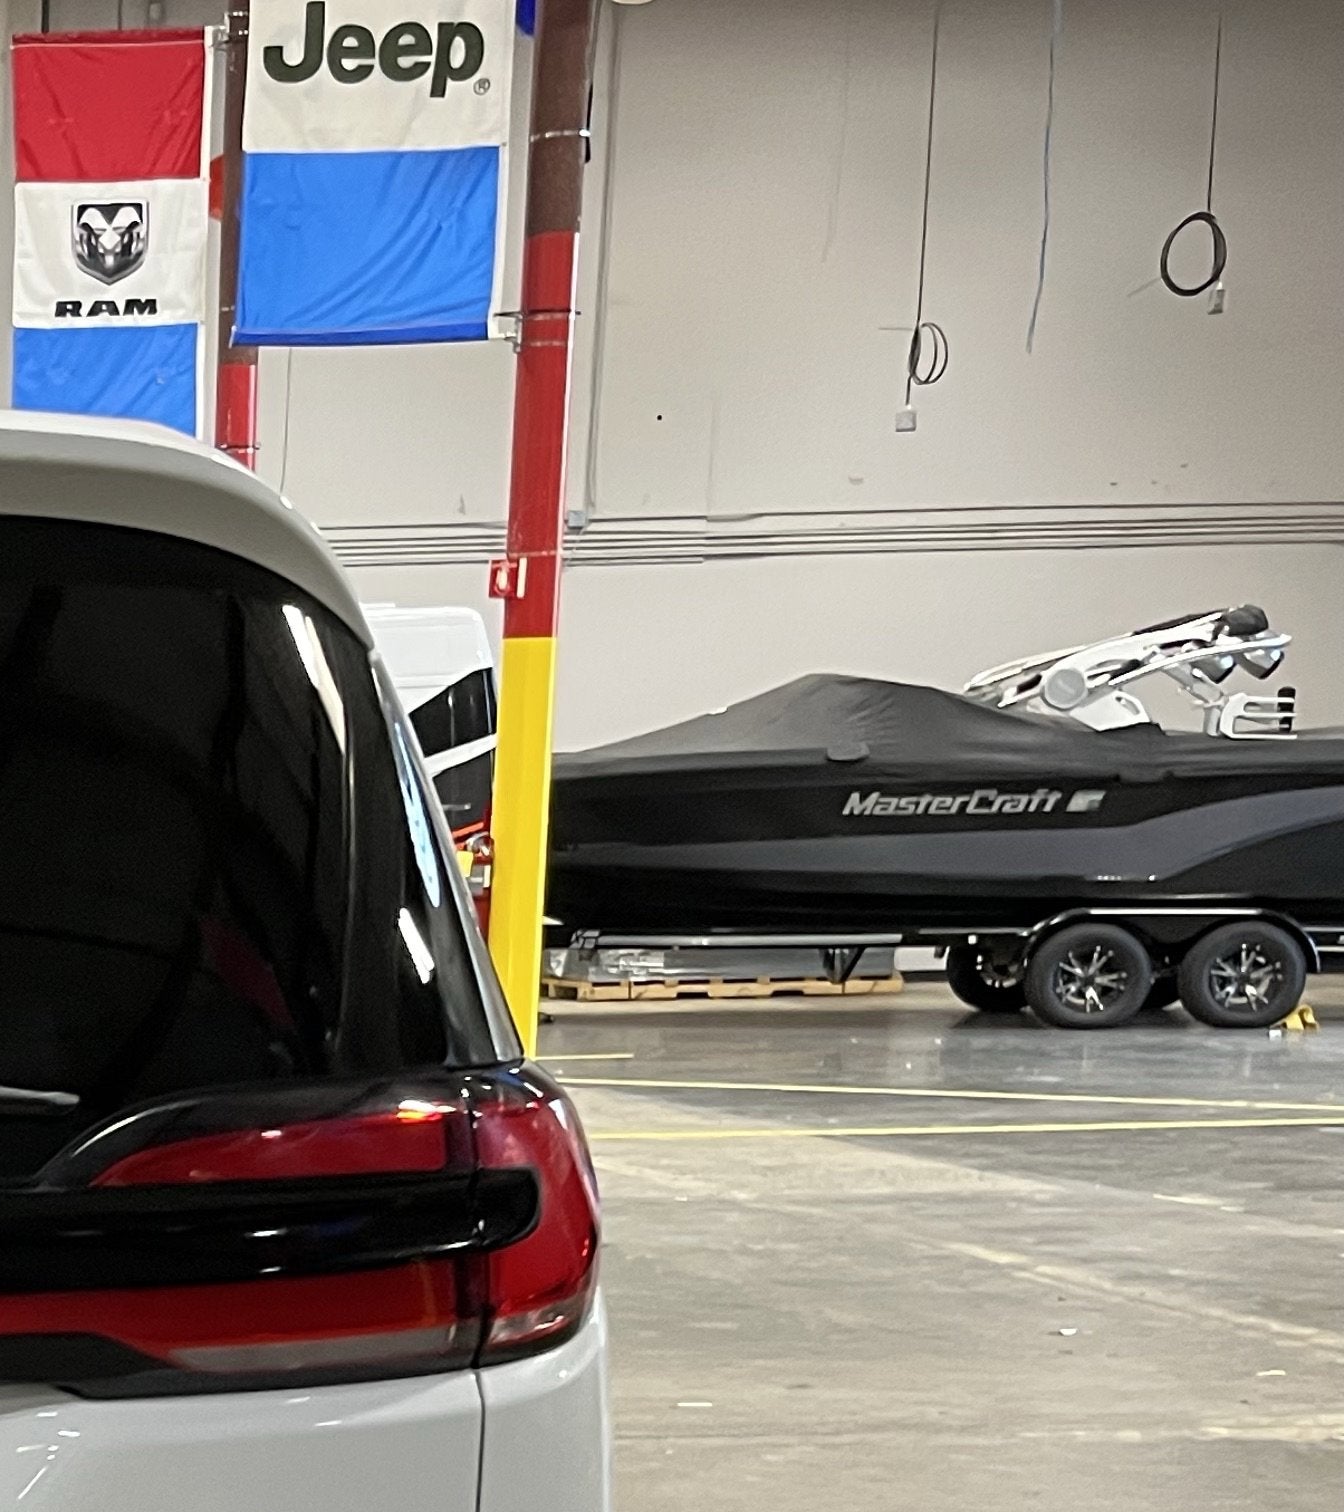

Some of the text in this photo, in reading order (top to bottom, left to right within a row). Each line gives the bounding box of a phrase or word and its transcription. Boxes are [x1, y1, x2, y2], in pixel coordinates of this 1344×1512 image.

[262, 0, 485, 98] Jeep
[54, 298, 158, 319] RAM
[842, 789, 1063, 815] MasterCraft
